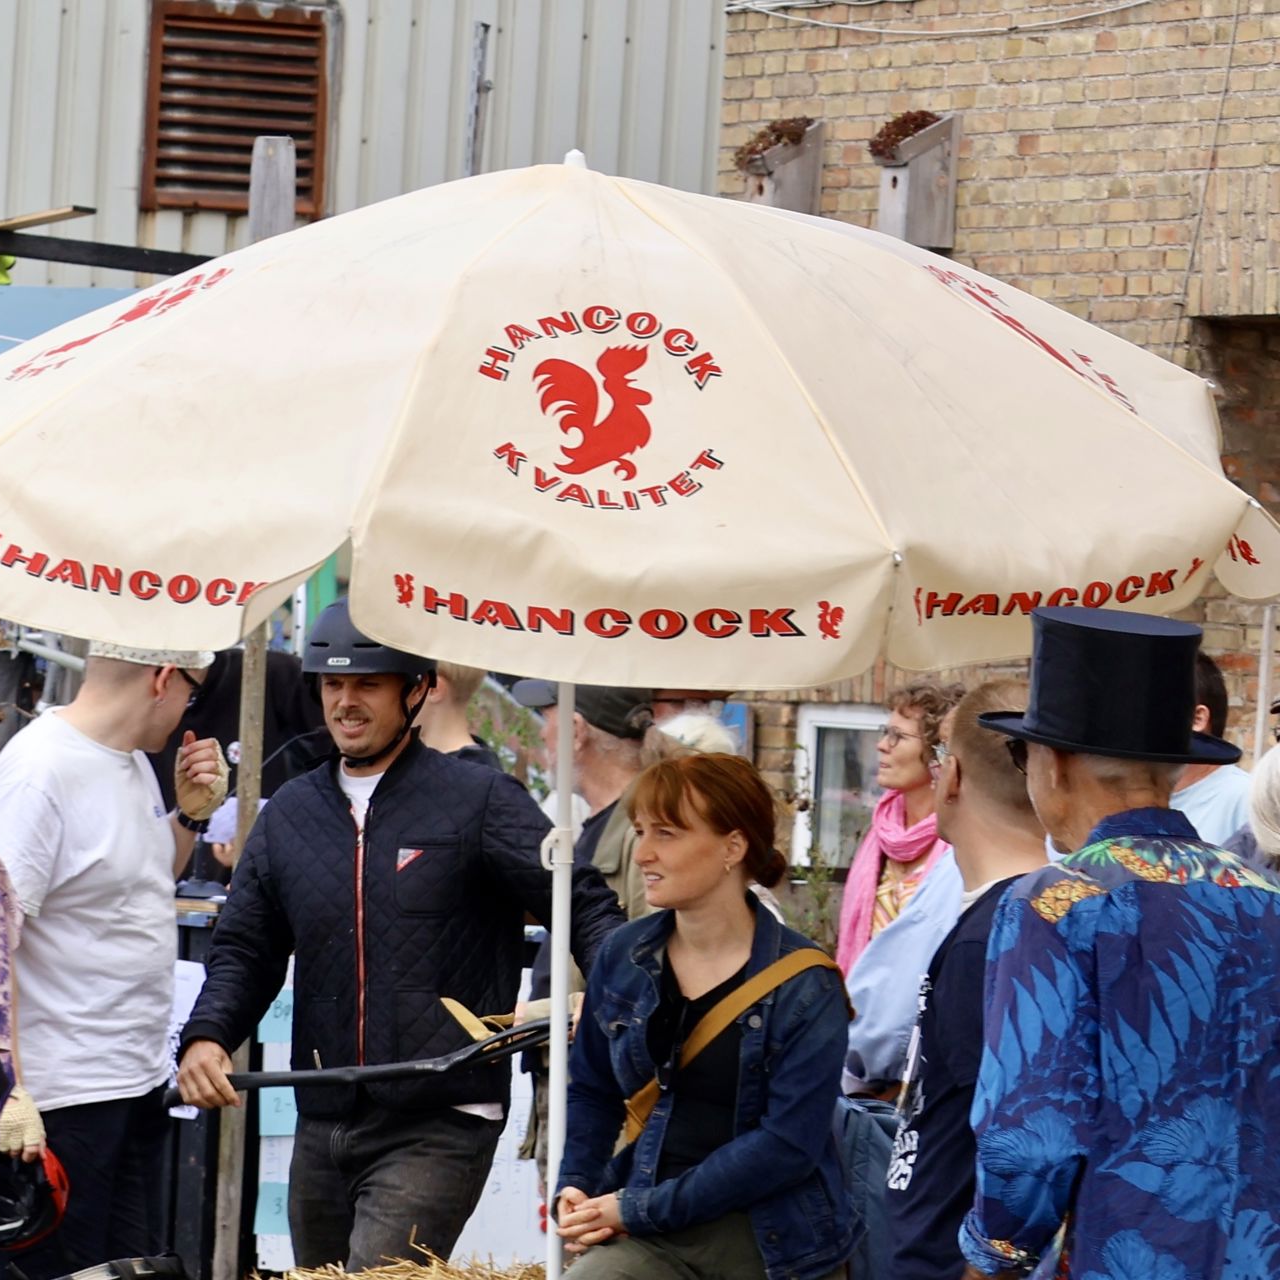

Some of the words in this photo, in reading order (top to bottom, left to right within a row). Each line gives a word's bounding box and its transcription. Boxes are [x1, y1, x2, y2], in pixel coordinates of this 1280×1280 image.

[478, 305, 723, 391] HANCOCK
[492, 449, 725, 510] KVALITET
[423, 585, 807, 639] HANCOCK
[925, 568, 1178, 619] HANCOCK
